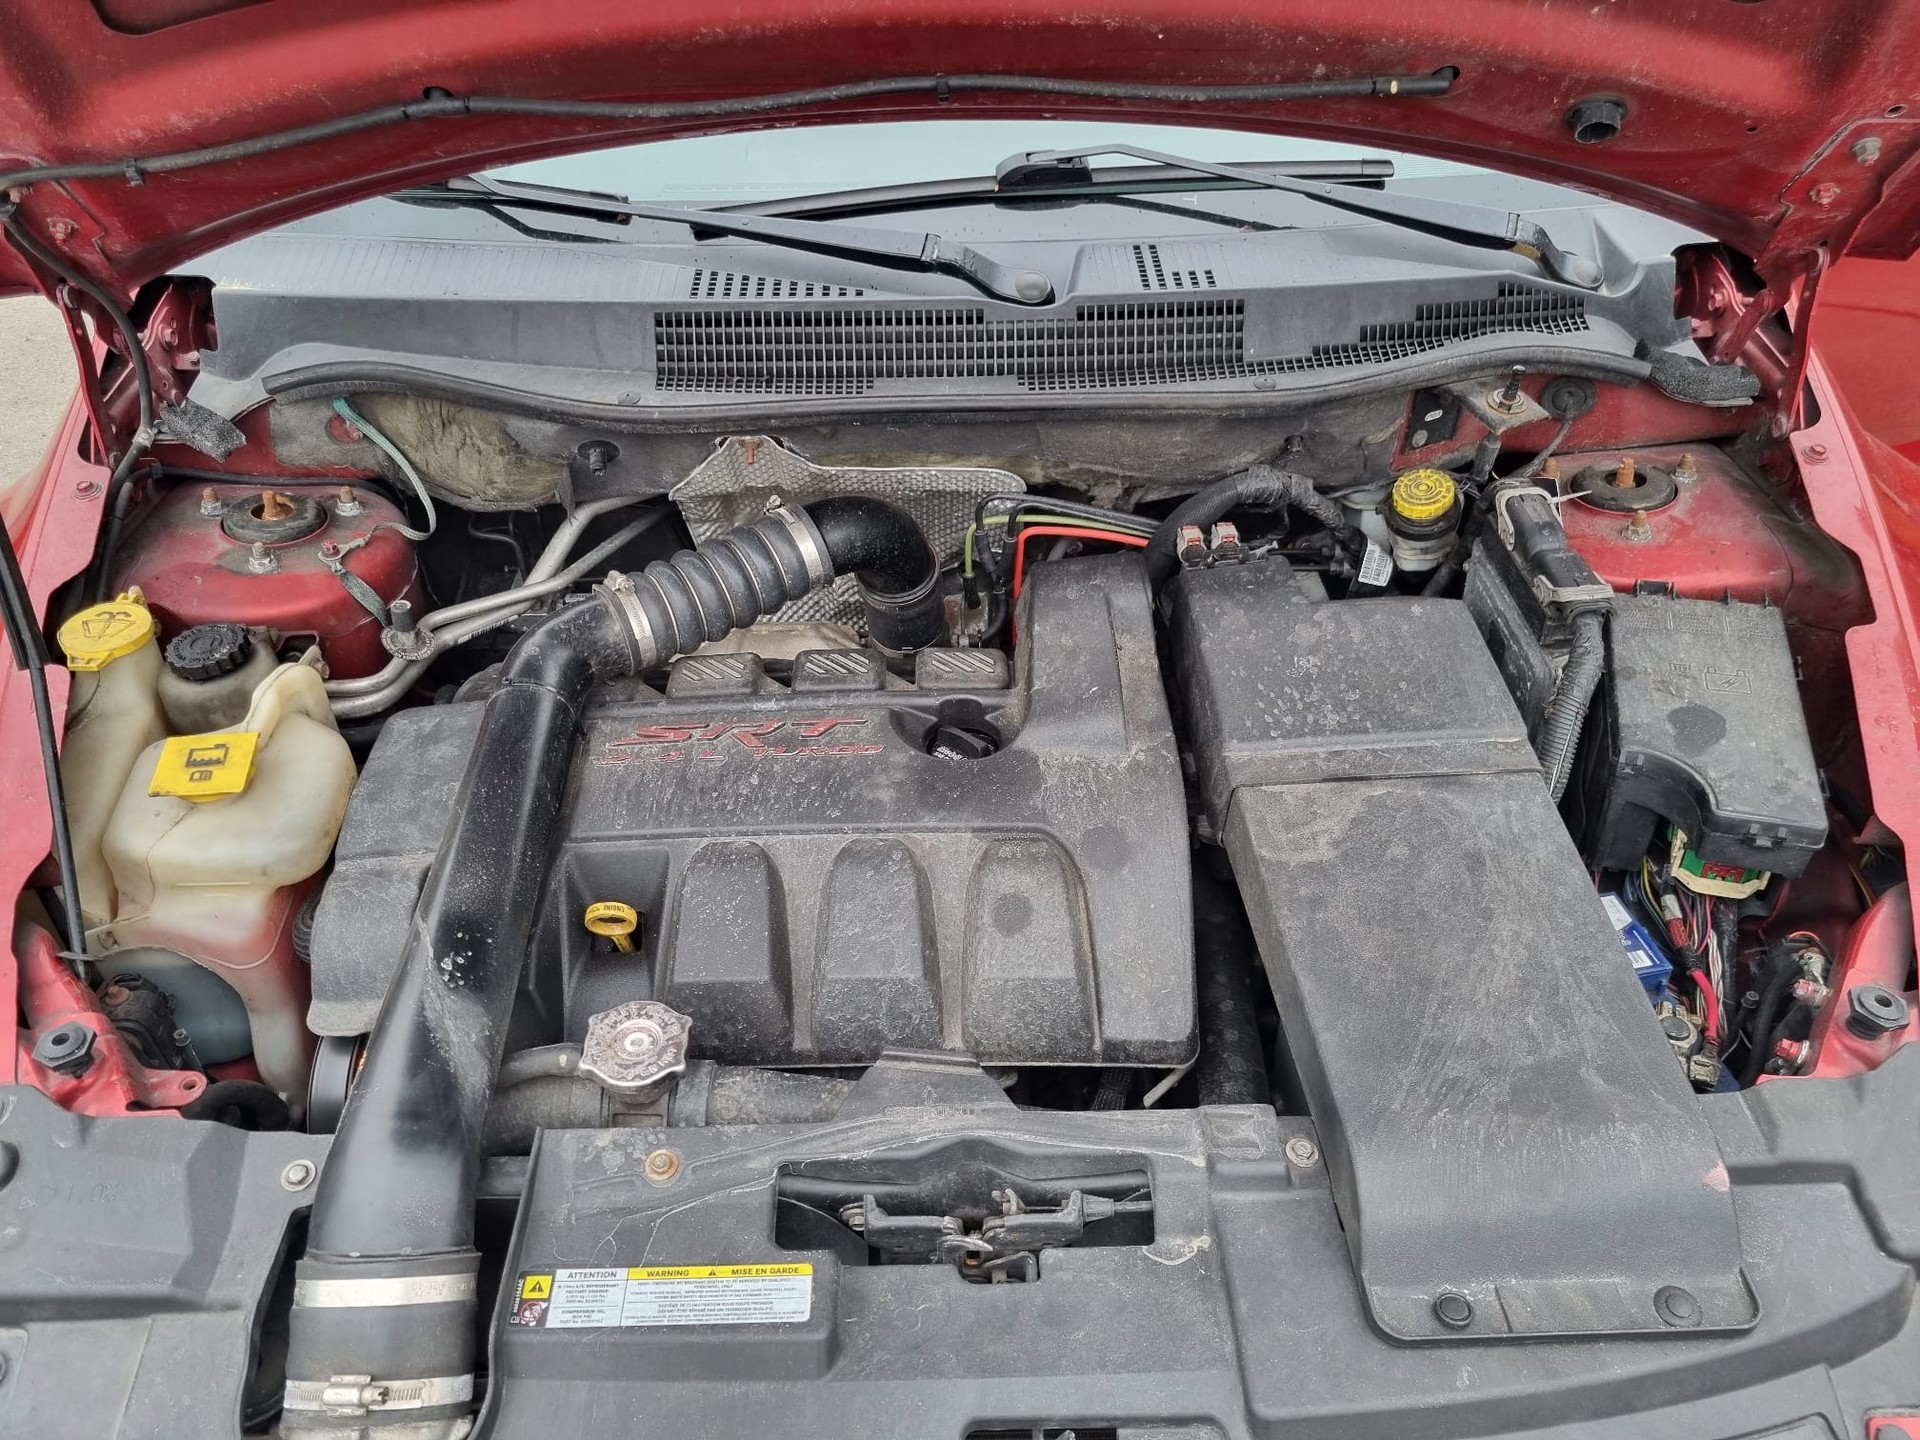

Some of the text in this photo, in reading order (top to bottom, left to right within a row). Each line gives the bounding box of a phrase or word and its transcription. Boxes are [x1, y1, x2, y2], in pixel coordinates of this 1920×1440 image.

[609, 717, 868, 747] SRT
[755, 744, 886, 758] TURBO
[603, 904, 625, 914] ENGINE
[567, 1271, 618, 1279] ATTENTION
[647, 1269, 690, 1277] WARNING
[731, 1268, 750, 1276] MISE
[769, 1266, 800, 1275] GARDE
